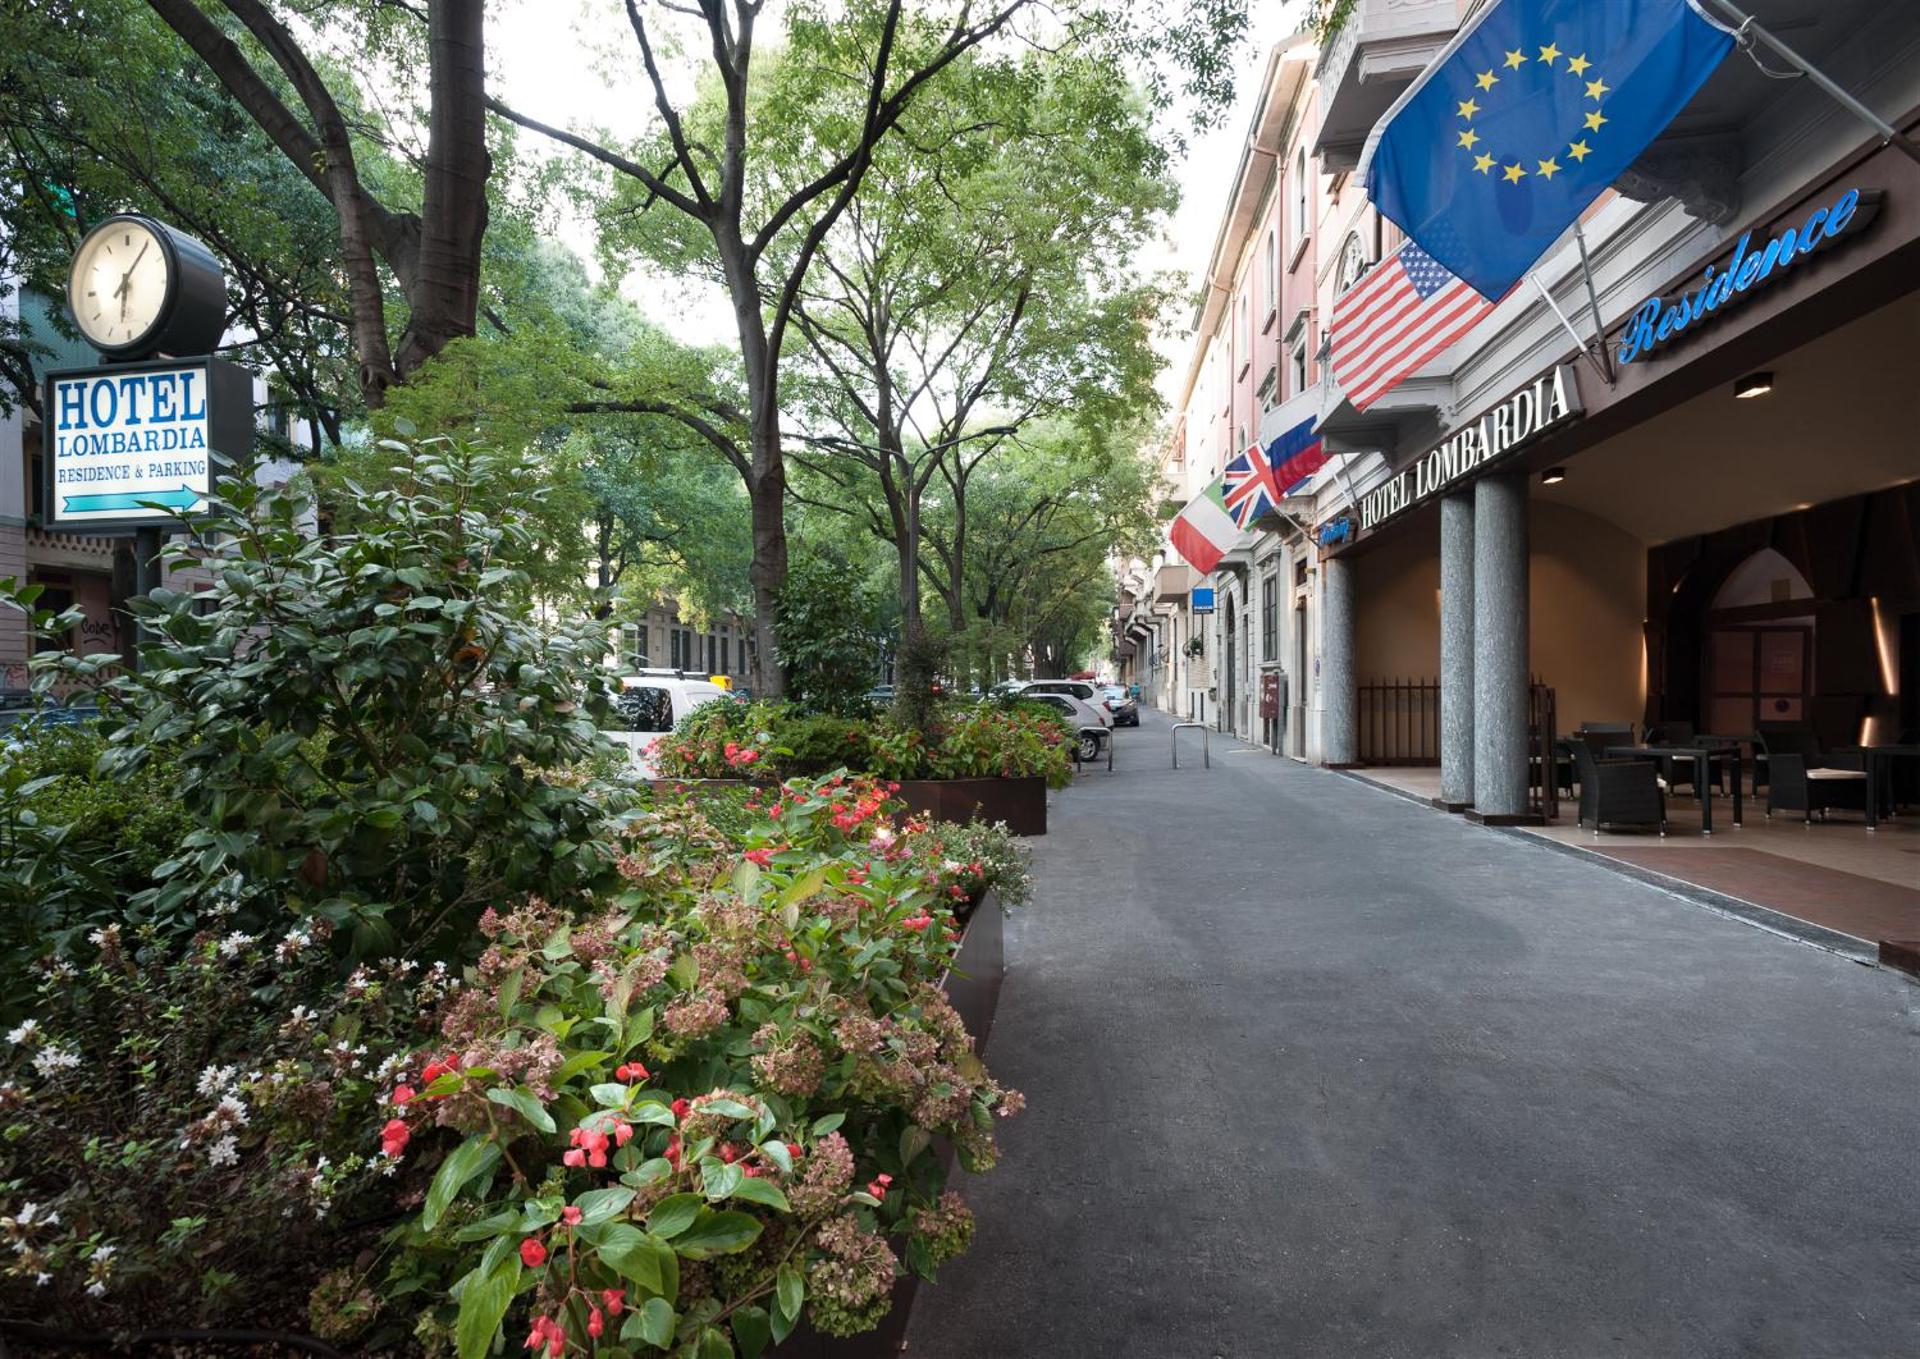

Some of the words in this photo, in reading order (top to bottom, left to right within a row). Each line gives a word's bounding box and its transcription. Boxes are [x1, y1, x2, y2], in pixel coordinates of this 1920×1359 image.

[1618, 188, 1860, 365] Residence
[58, 372, 205, 430] HOTEL
[58, 427, 205, 457] LOMBARDIA
[1361, 471, 1411, 531] HOTEL
[1416, 365, 1570, 499] LOMBARDIA
[58, 465, 130, 483] RESIDENCE
[135, 464, 143, 478] &
[149, 460, 205, 478] PARKING
